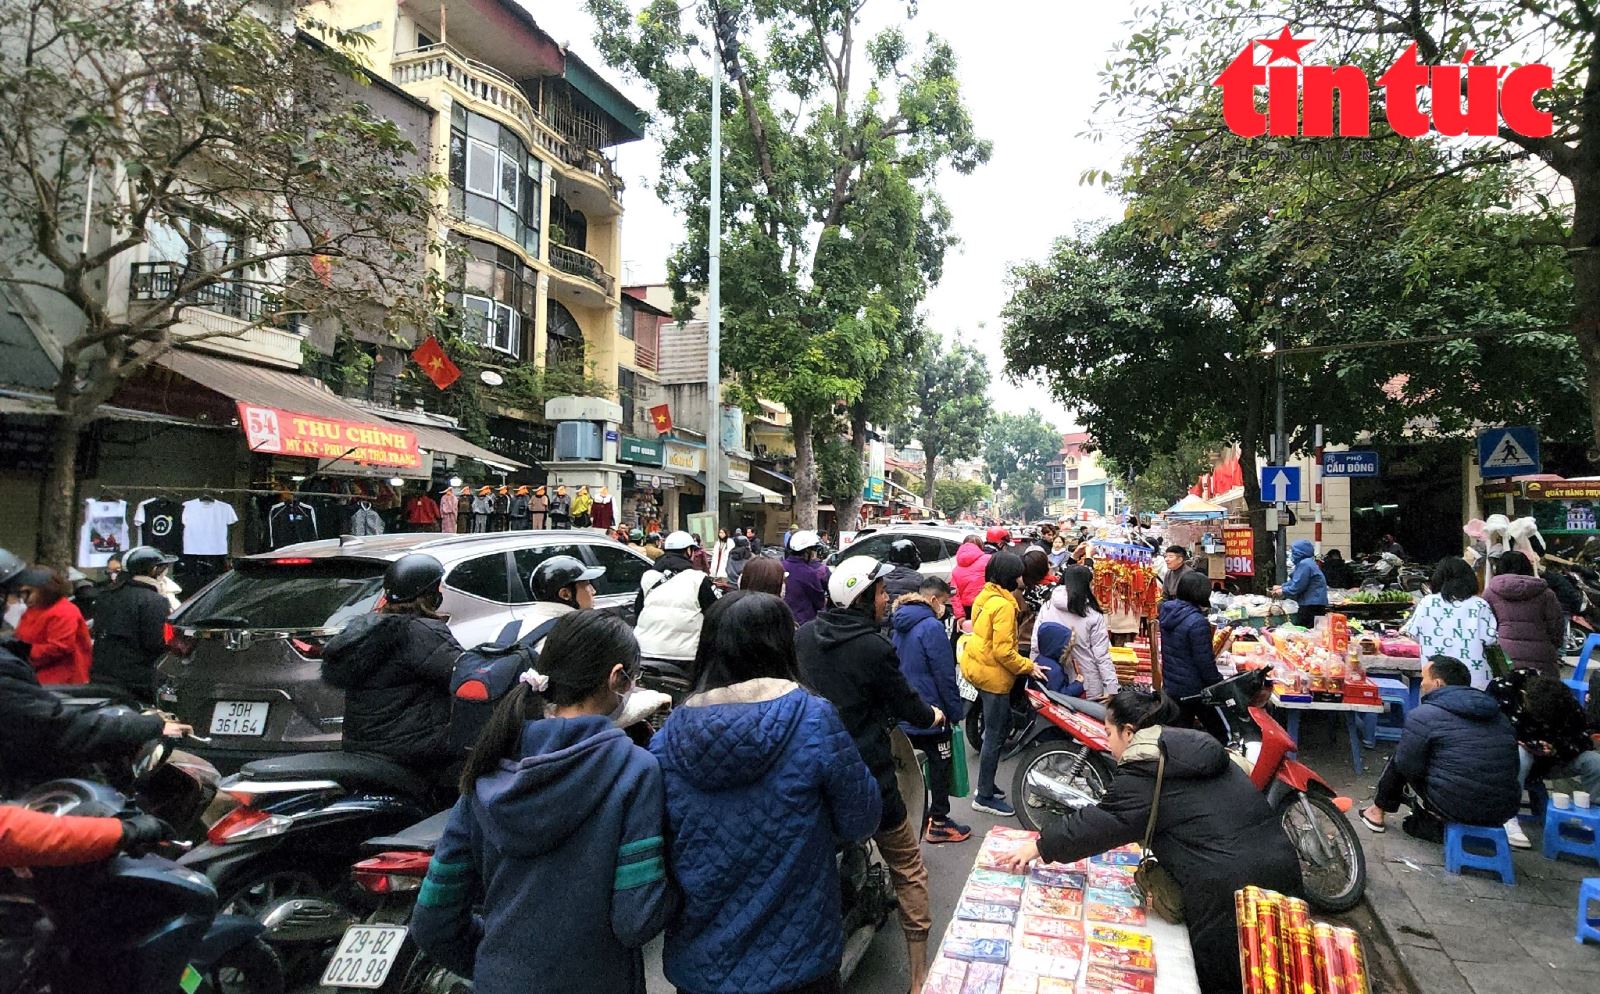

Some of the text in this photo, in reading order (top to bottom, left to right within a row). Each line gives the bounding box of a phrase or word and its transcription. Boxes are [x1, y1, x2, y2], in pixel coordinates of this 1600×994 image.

[249, 411, 276, 435] 54
[293, 418, 341, 440] THU
[228, 703, 253, 717] 30H
[215, 718, 258, 734] 361.64
[327, 957, 387, 983] 020.98
